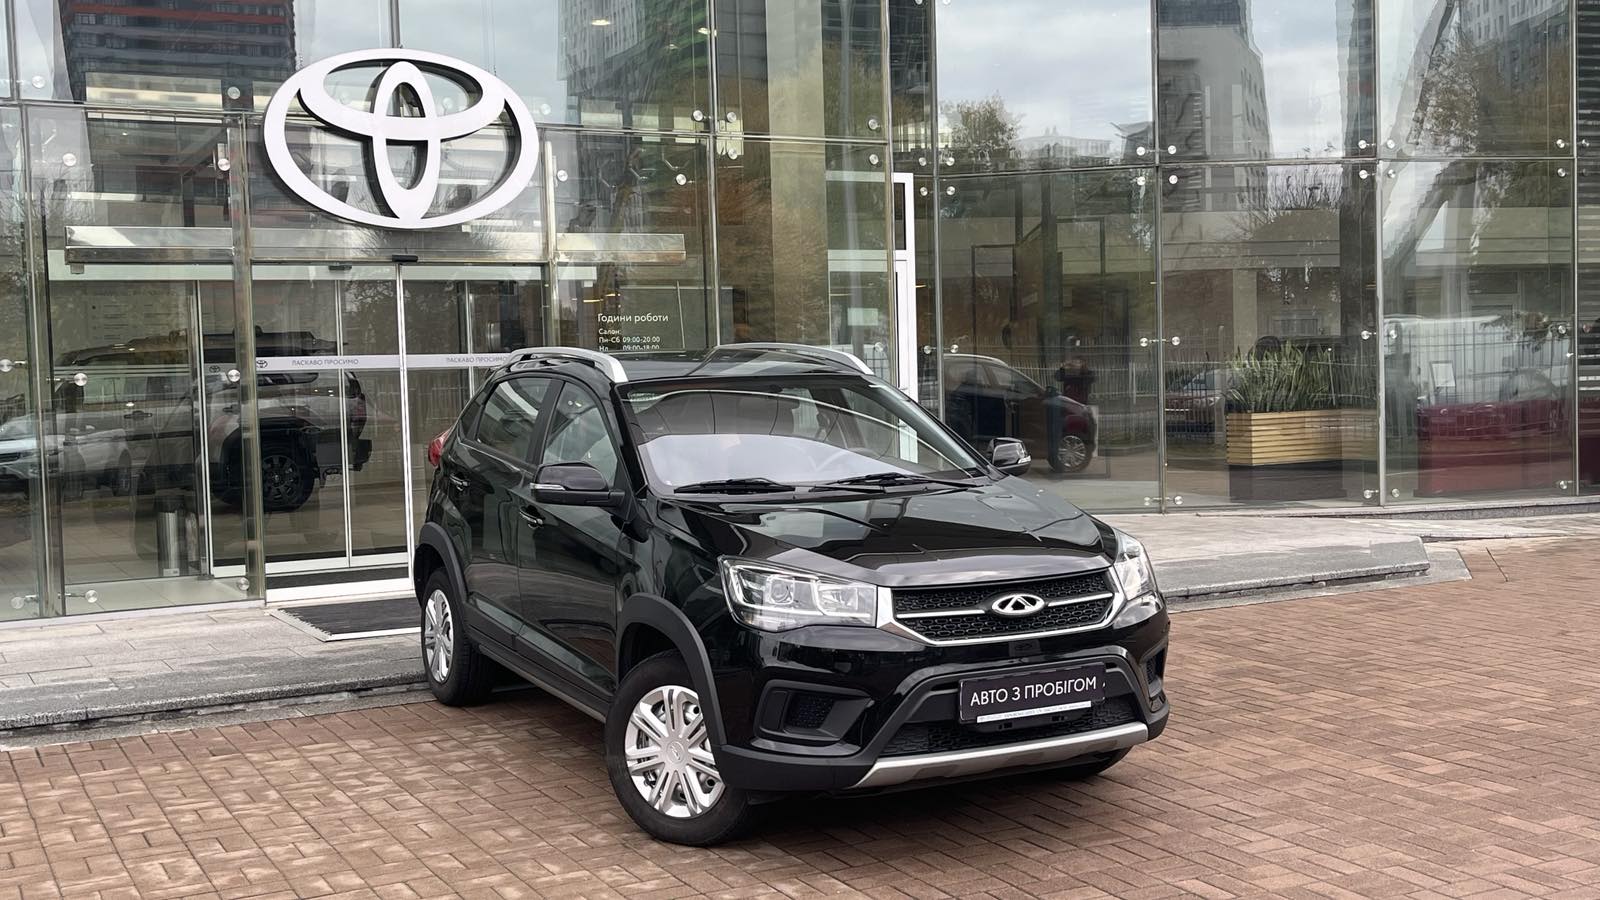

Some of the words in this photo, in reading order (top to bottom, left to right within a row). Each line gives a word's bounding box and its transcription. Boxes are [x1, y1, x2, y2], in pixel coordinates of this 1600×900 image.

[597, 313, 632, 323] Години
[634, 313, 669, 324] роботи
[970, 688, 1008, 707] АВТО
[1024, 676, 1097, 699] ПРОБІГОМ
